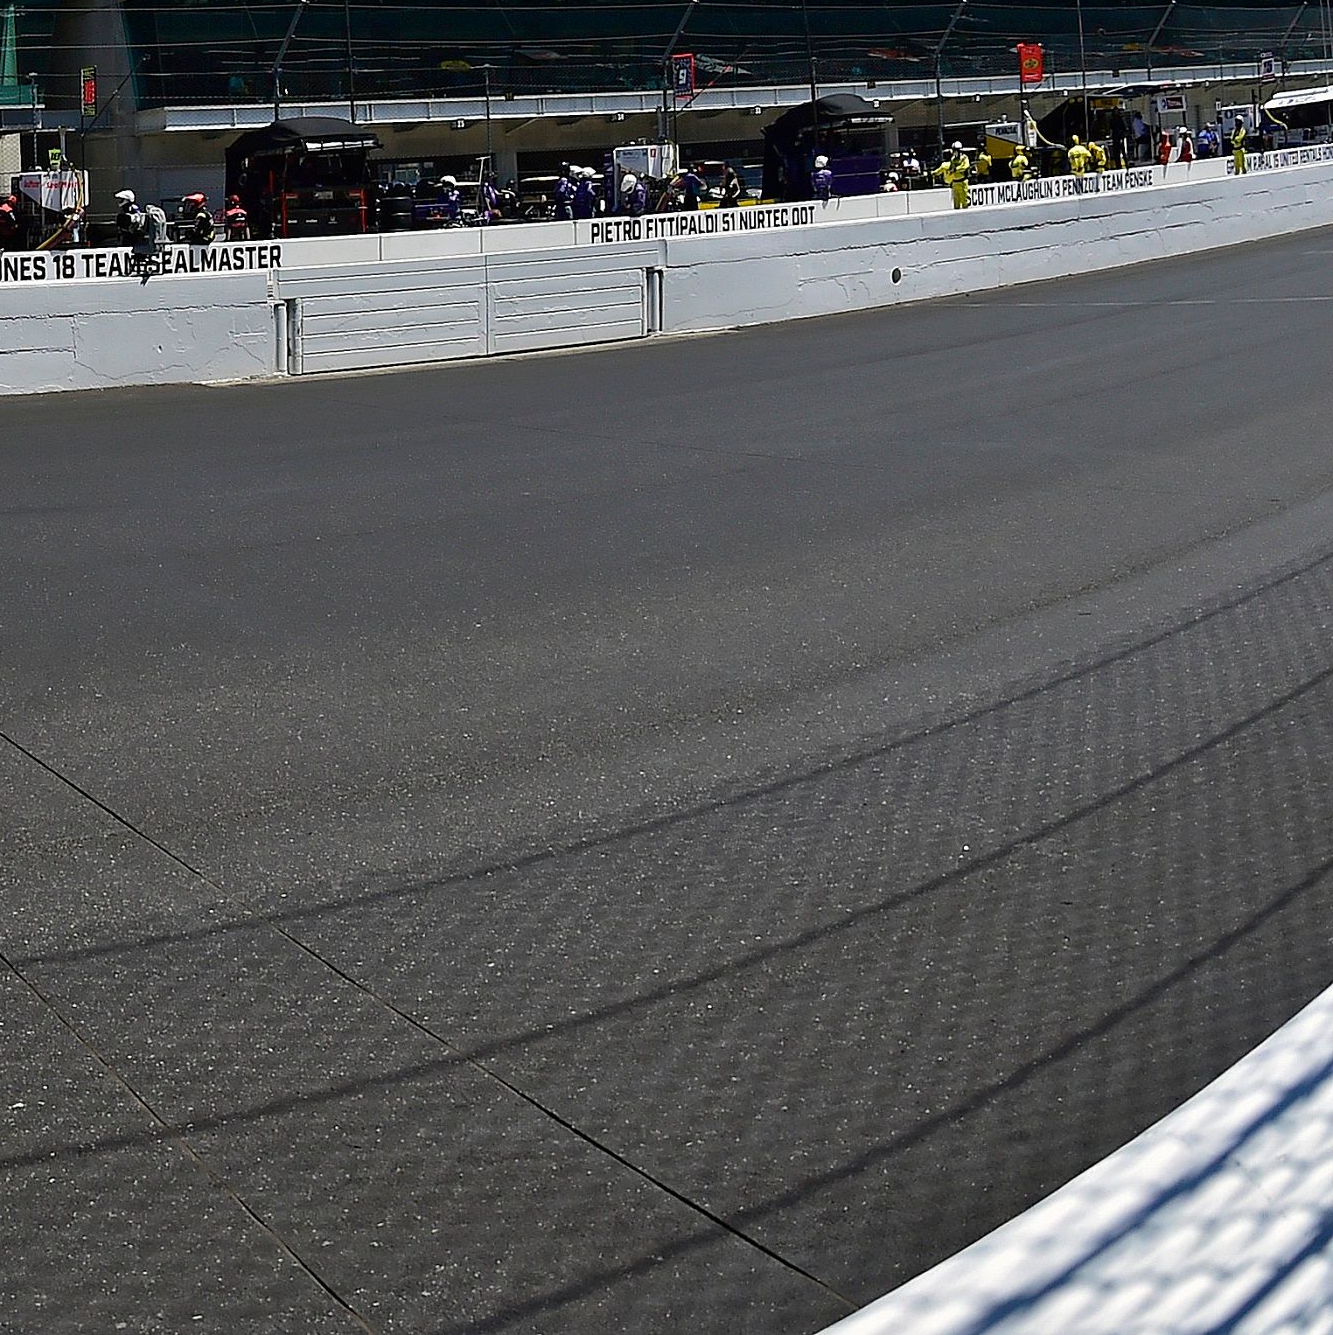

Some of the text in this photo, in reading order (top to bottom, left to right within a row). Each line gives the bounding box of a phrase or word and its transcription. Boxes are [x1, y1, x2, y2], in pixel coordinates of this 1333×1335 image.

[967, 186, 995, 206] SCOTT
[997, 181, 1053, 203] MCLAUGHLIN
[1101, 174, 1123, 191] TEAM
[1124, 170, 1153, 189] PENSKE
[591, 206, 816, 244] PIETRO FITTIPALDI 51 NURTEC ODT
[54, 254, 76, 280] 18
